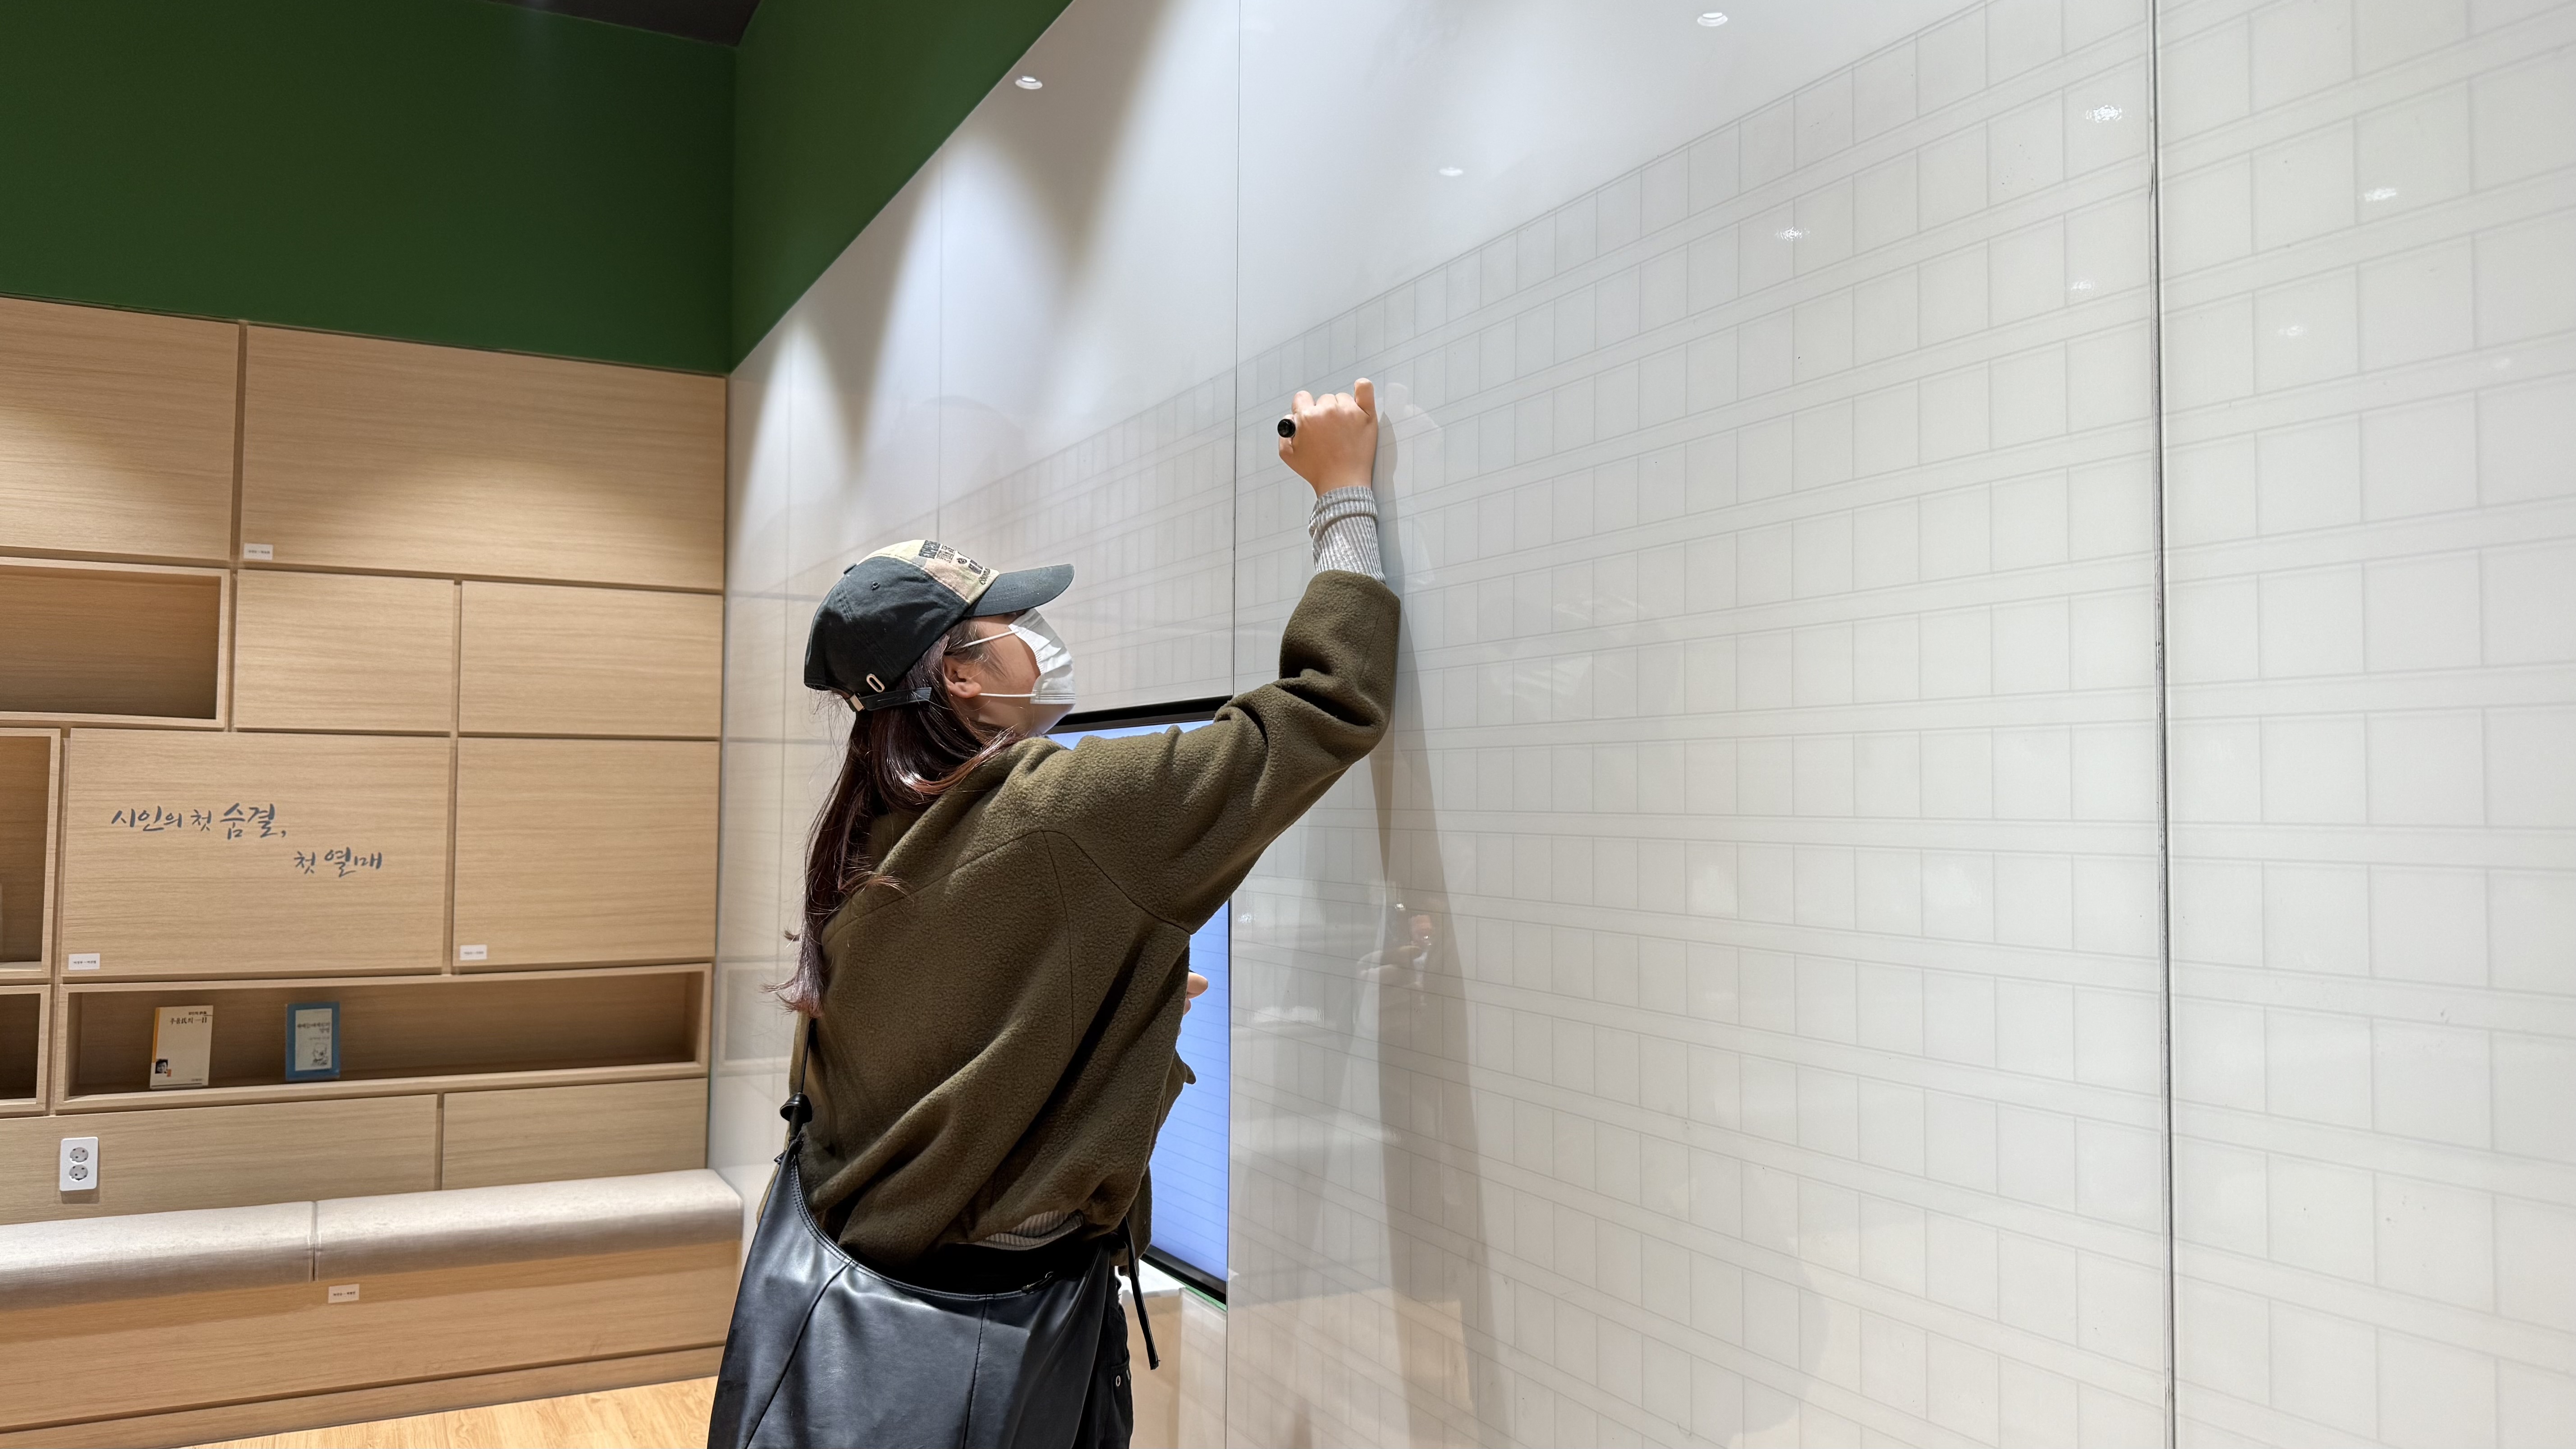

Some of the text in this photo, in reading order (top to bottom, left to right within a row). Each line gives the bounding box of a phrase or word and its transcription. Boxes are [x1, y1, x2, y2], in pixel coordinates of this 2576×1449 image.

[111, 803, 286, 840] 시인의 첫 숨결,
[294, 847, 382, 878] 첫 열매
